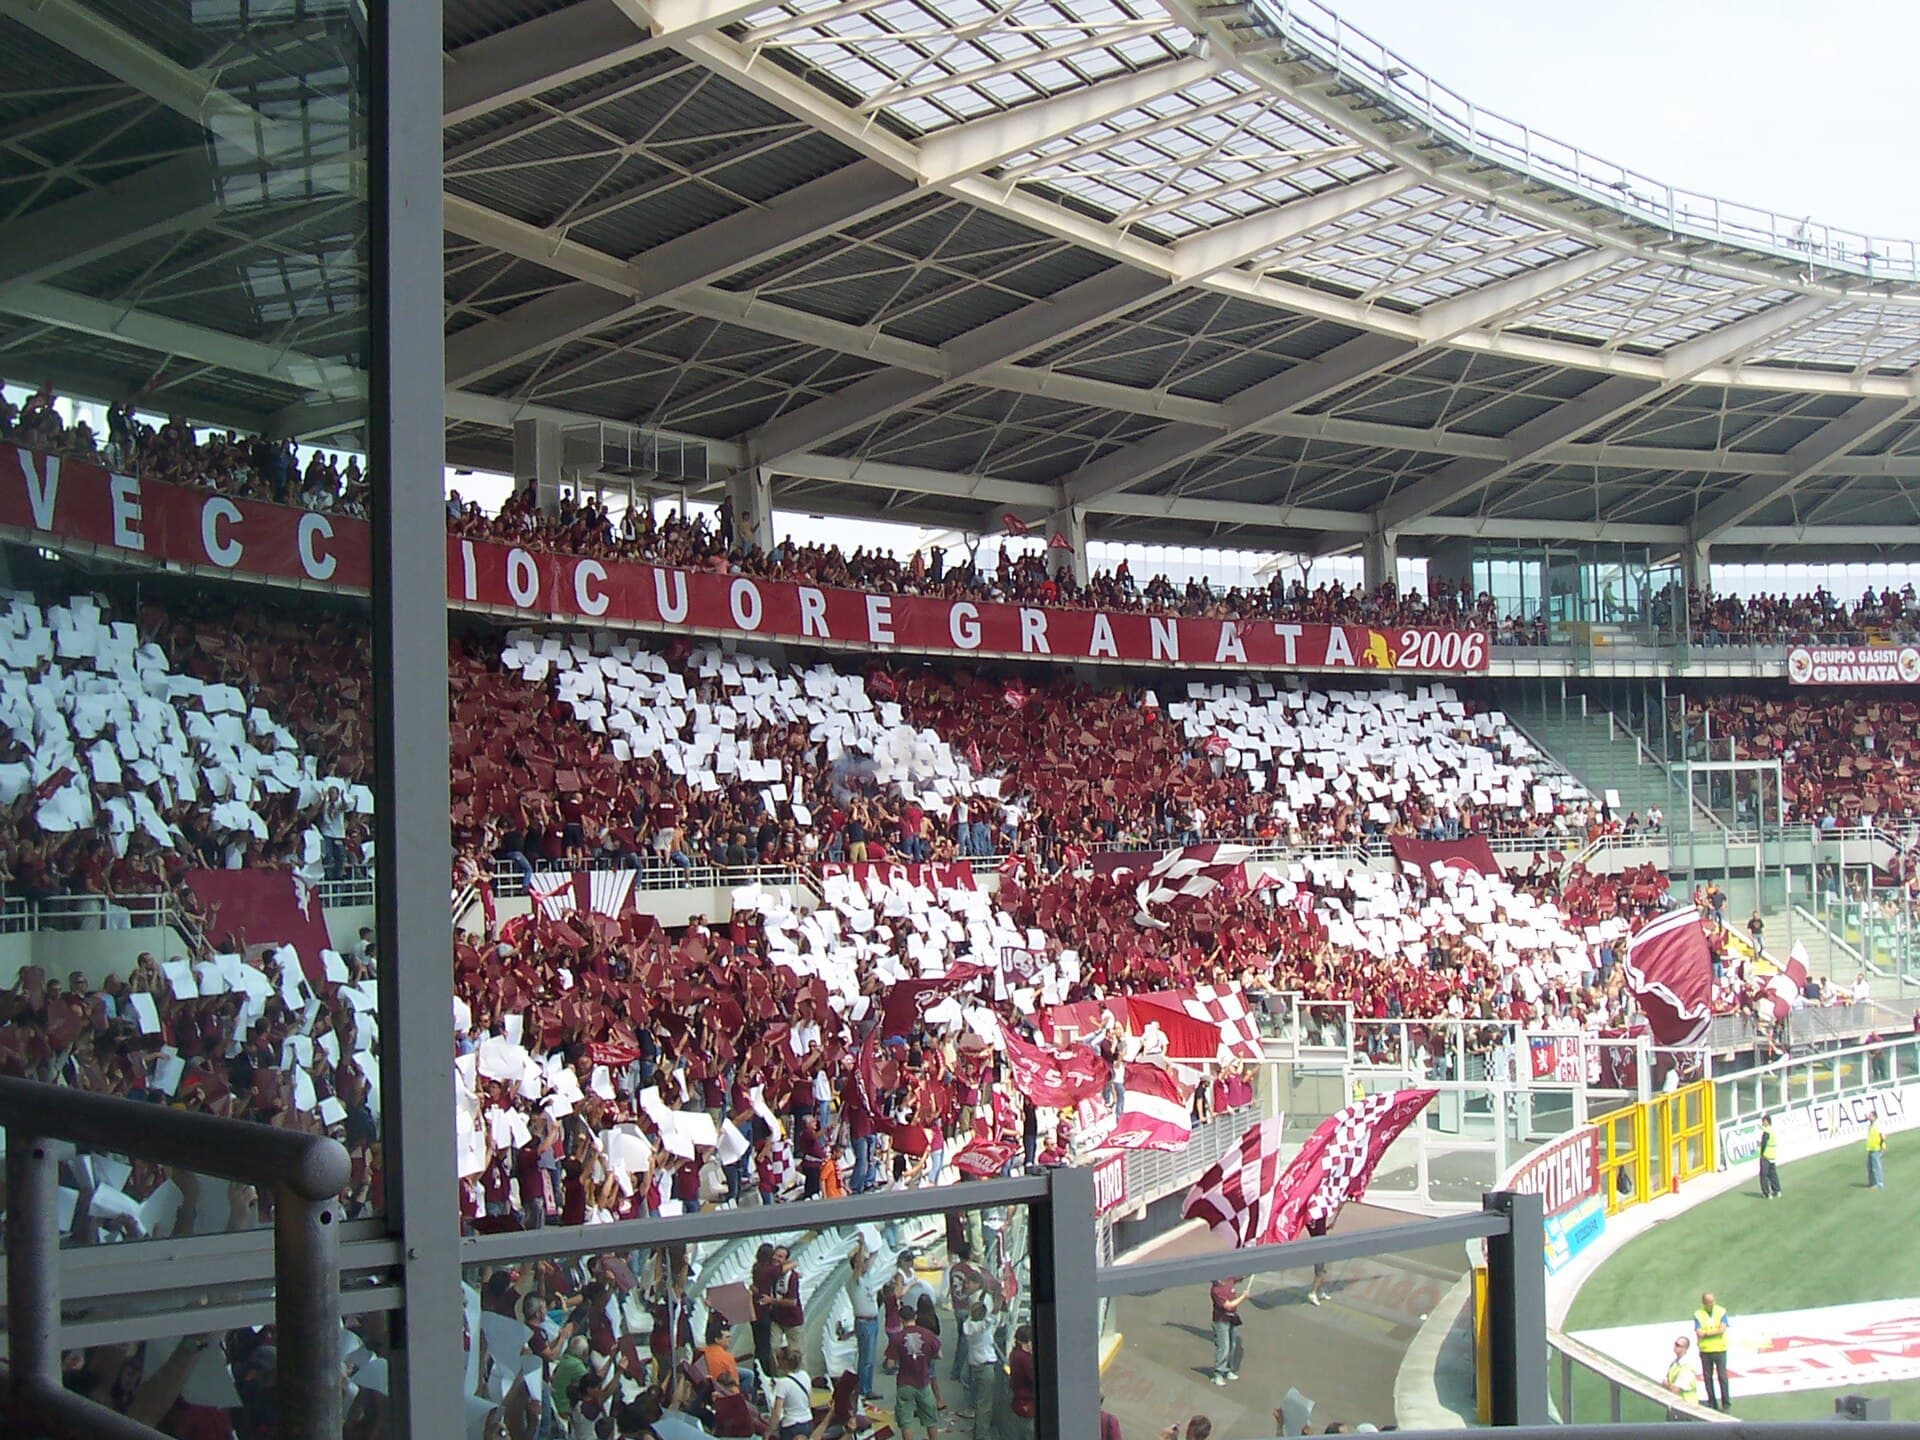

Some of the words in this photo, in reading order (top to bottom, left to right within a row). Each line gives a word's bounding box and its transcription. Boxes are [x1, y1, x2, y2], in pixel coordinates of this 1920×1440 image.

[574, 558, 896, 645] CUORE
[948, 601, 1356, 666] GRANATA
[1396, 629, 1485, 669] 2006
[1812, 650, 1856, 664] GRUPPO
[1812, 666, 1900, 682] GRANATA
